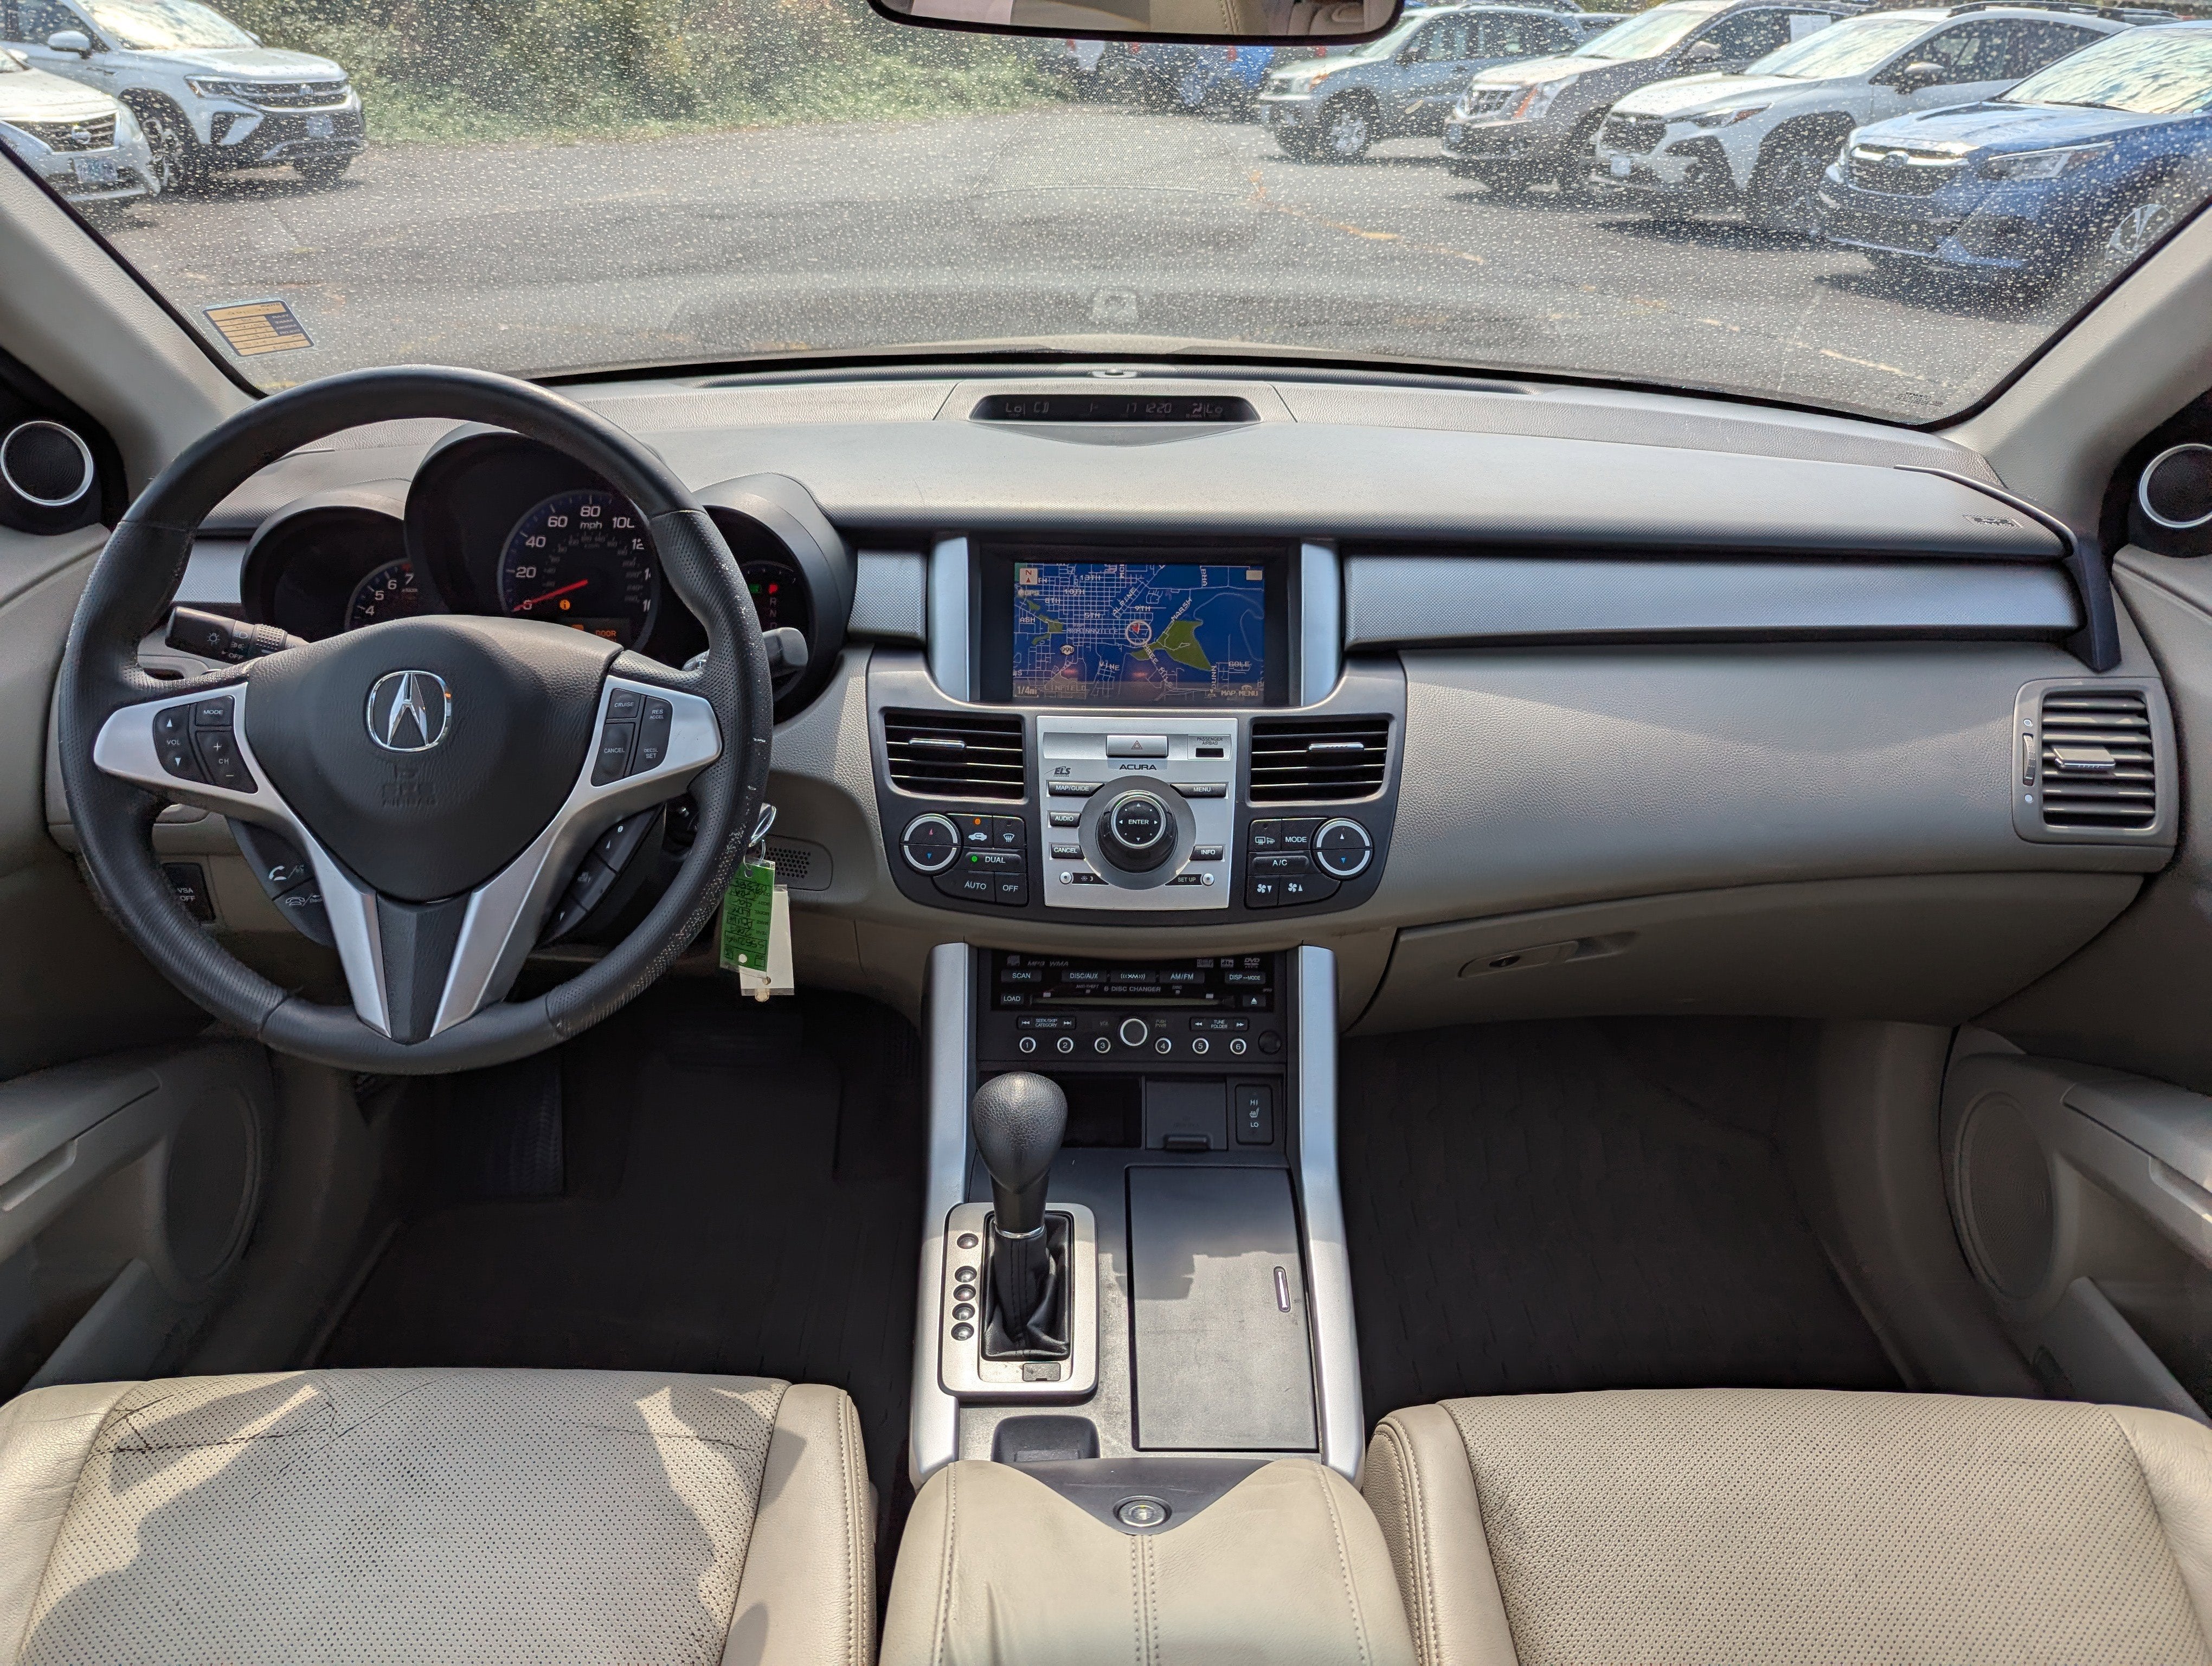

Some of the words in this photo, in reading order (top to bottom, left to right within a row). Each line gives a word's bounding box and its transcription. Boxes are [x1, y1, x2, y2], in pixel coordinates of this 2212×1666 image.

[580, 505, 601, 517] 80
[548, 516, 568, 528] 60
[580, 521, 602, 529] mph
[525, 536, 546, 548] 40
[516, 566, 537, 578] 20
[405, 573, 414, 585] 7
[388, 579, 397, 590] 6
[375, 590, 384, 600] 5
[769, 597, 777, 607] R
[365, 605, 375, 617] 4
[769, 609, 777, 617] N
[1171, 597, 1192, 622] MARSH
[1017, 685, 1037, 695] 1/4mi
[1054, 767, 1071, 775] ELS
[964, 880, 987, 890] AUTO
[1002, 885, 1019, 893] OFF
